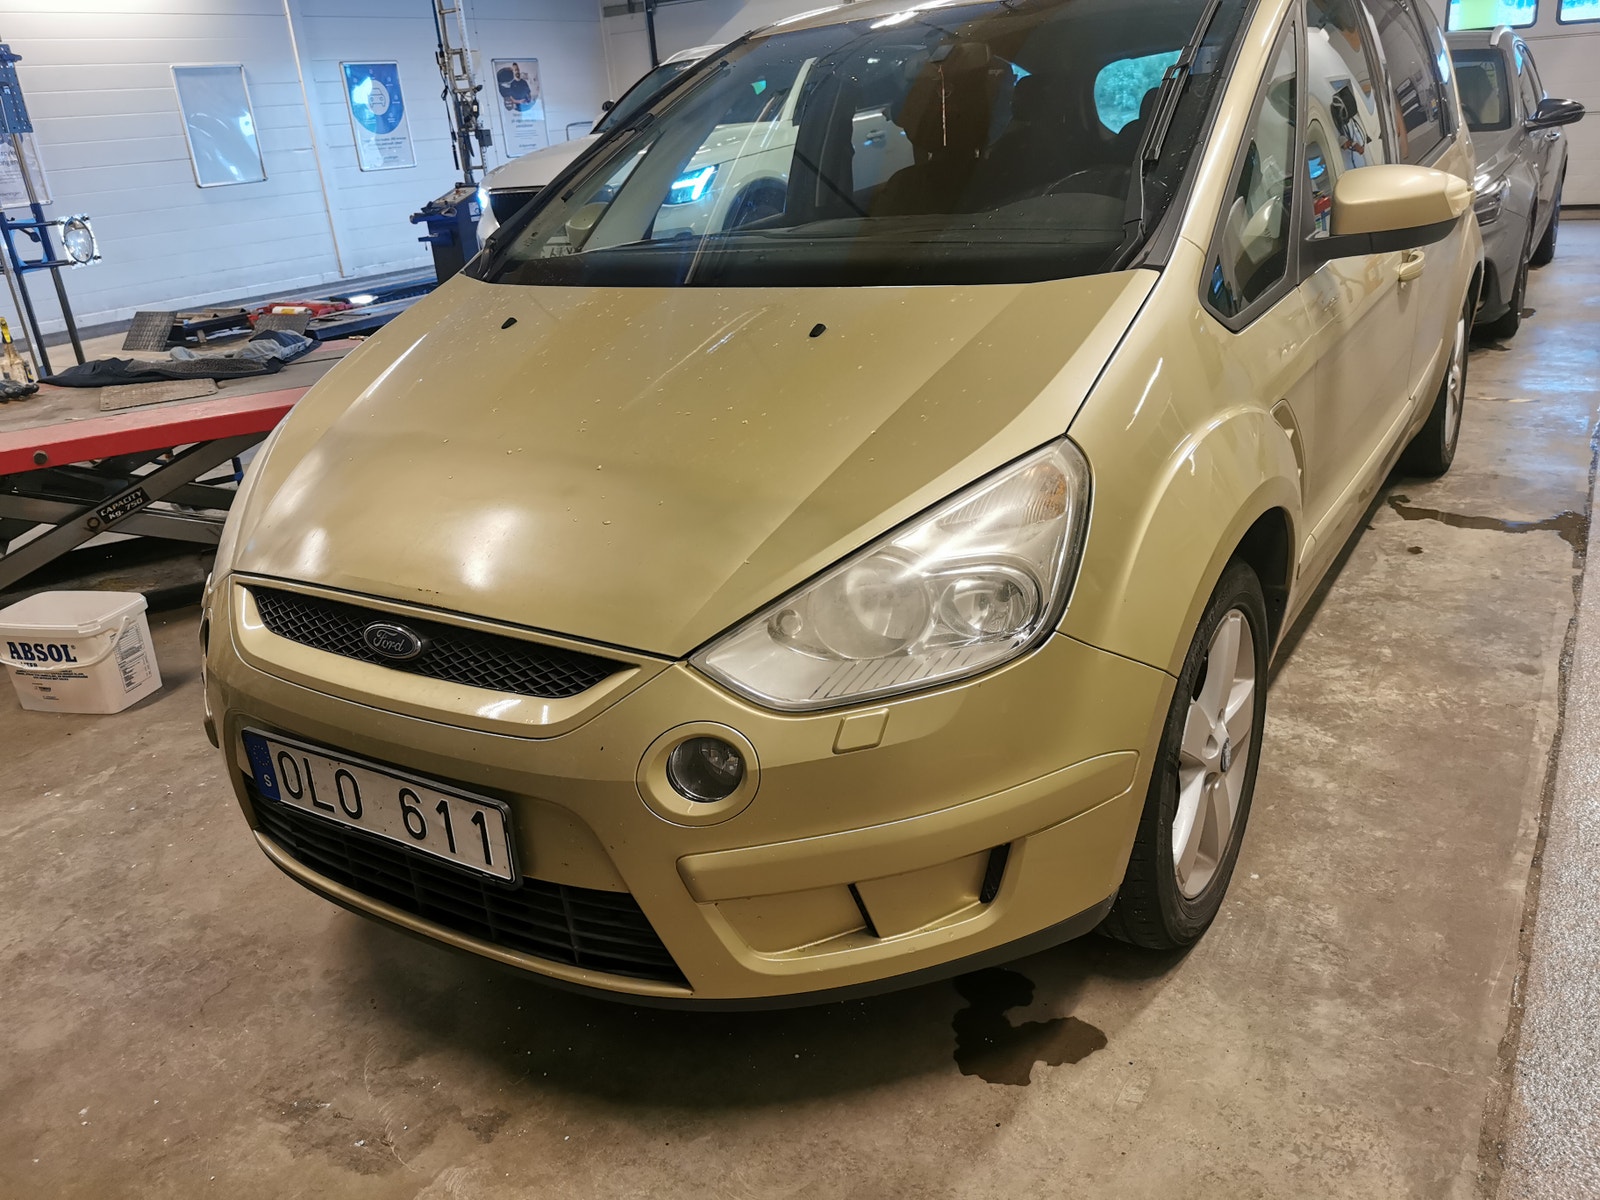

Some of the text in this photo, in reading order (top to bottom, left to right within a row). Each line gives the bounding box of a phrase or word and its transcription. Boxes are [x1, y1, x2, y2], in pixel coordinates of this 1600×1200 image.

[100, 489, 142, 516] CAPACITY
[125, 497, 143, 510] 750
[373, 630, 405, 652] Ford
[263, 774, 272, 788] S
[277, 750, 494, 866] OLO 611
